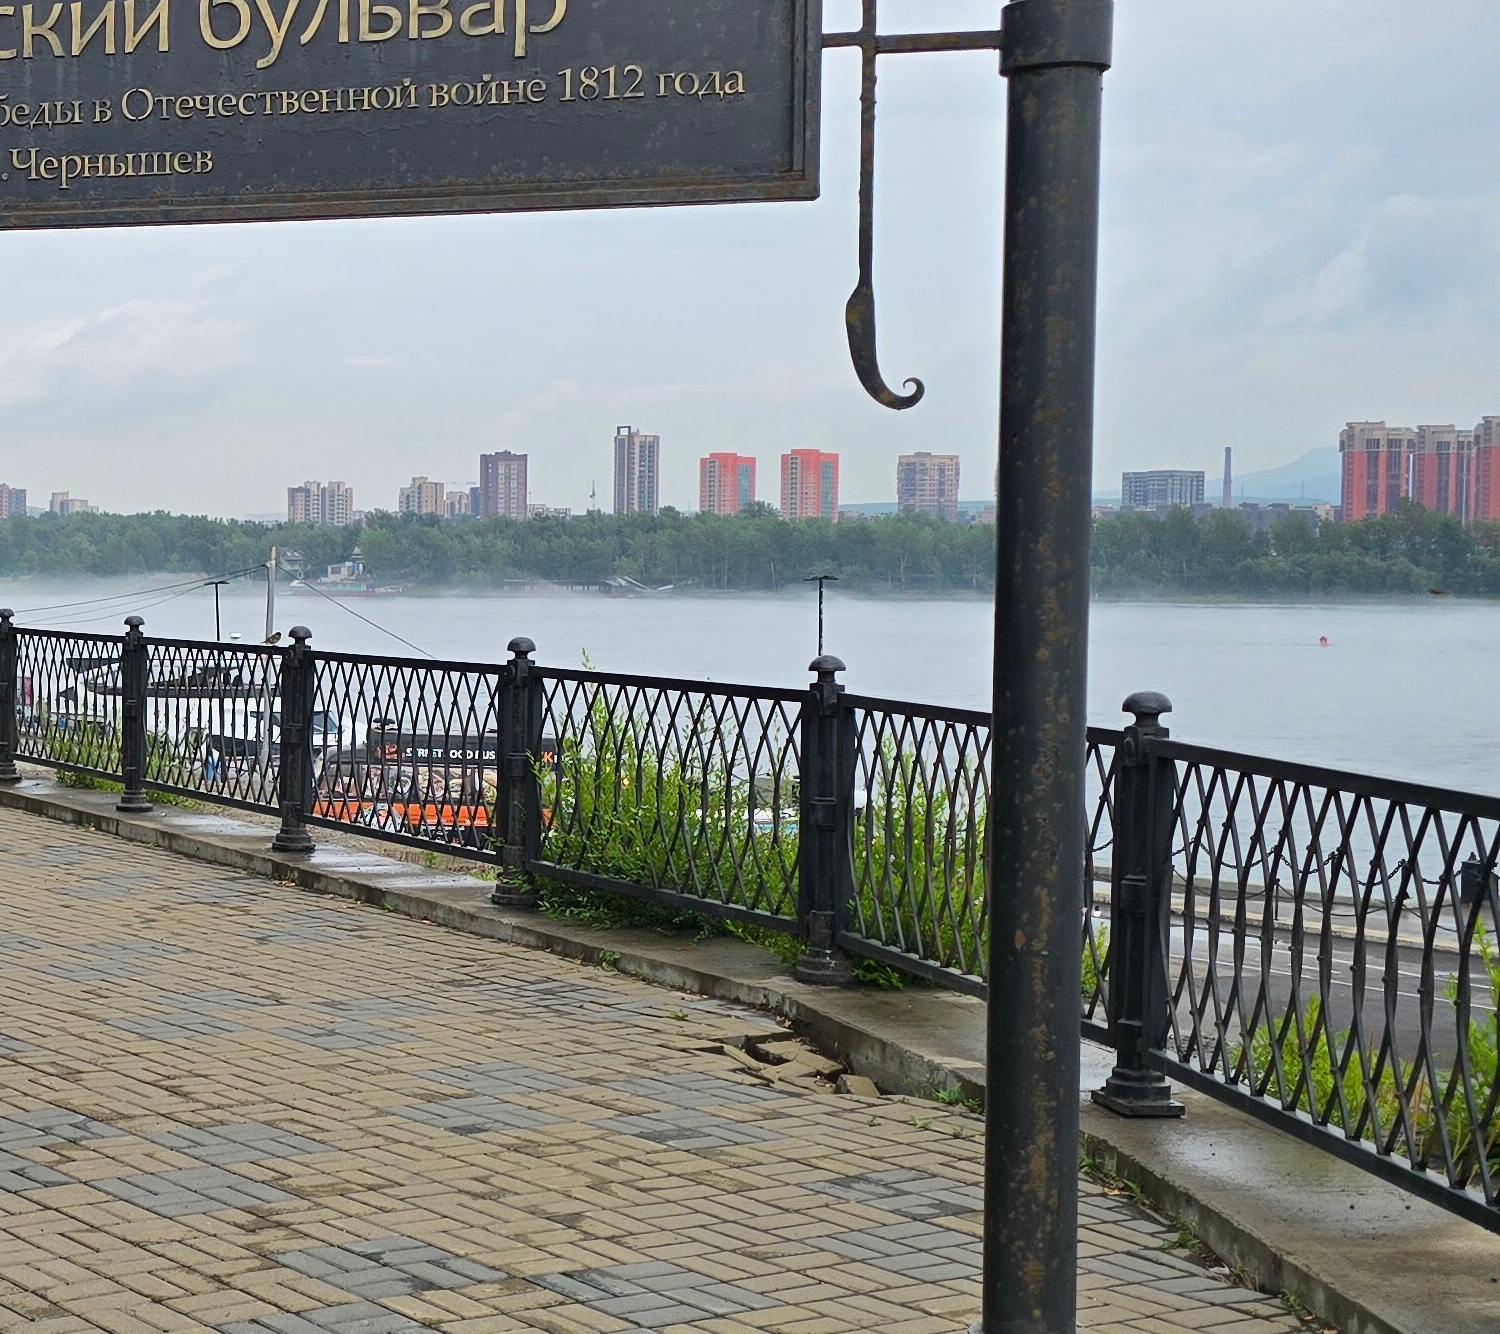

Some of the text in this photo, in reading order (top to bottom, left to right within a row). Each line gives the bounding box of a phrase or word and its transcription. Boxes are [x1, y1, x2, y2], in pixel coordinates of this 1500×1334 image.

[92, 99, 112, 123] в
[121, 77, 420, 121] Отечественной
[428, 73, 547, 108] войне
[558, 64, 645, 102] 1812
[656, 70, 746, 101] года
